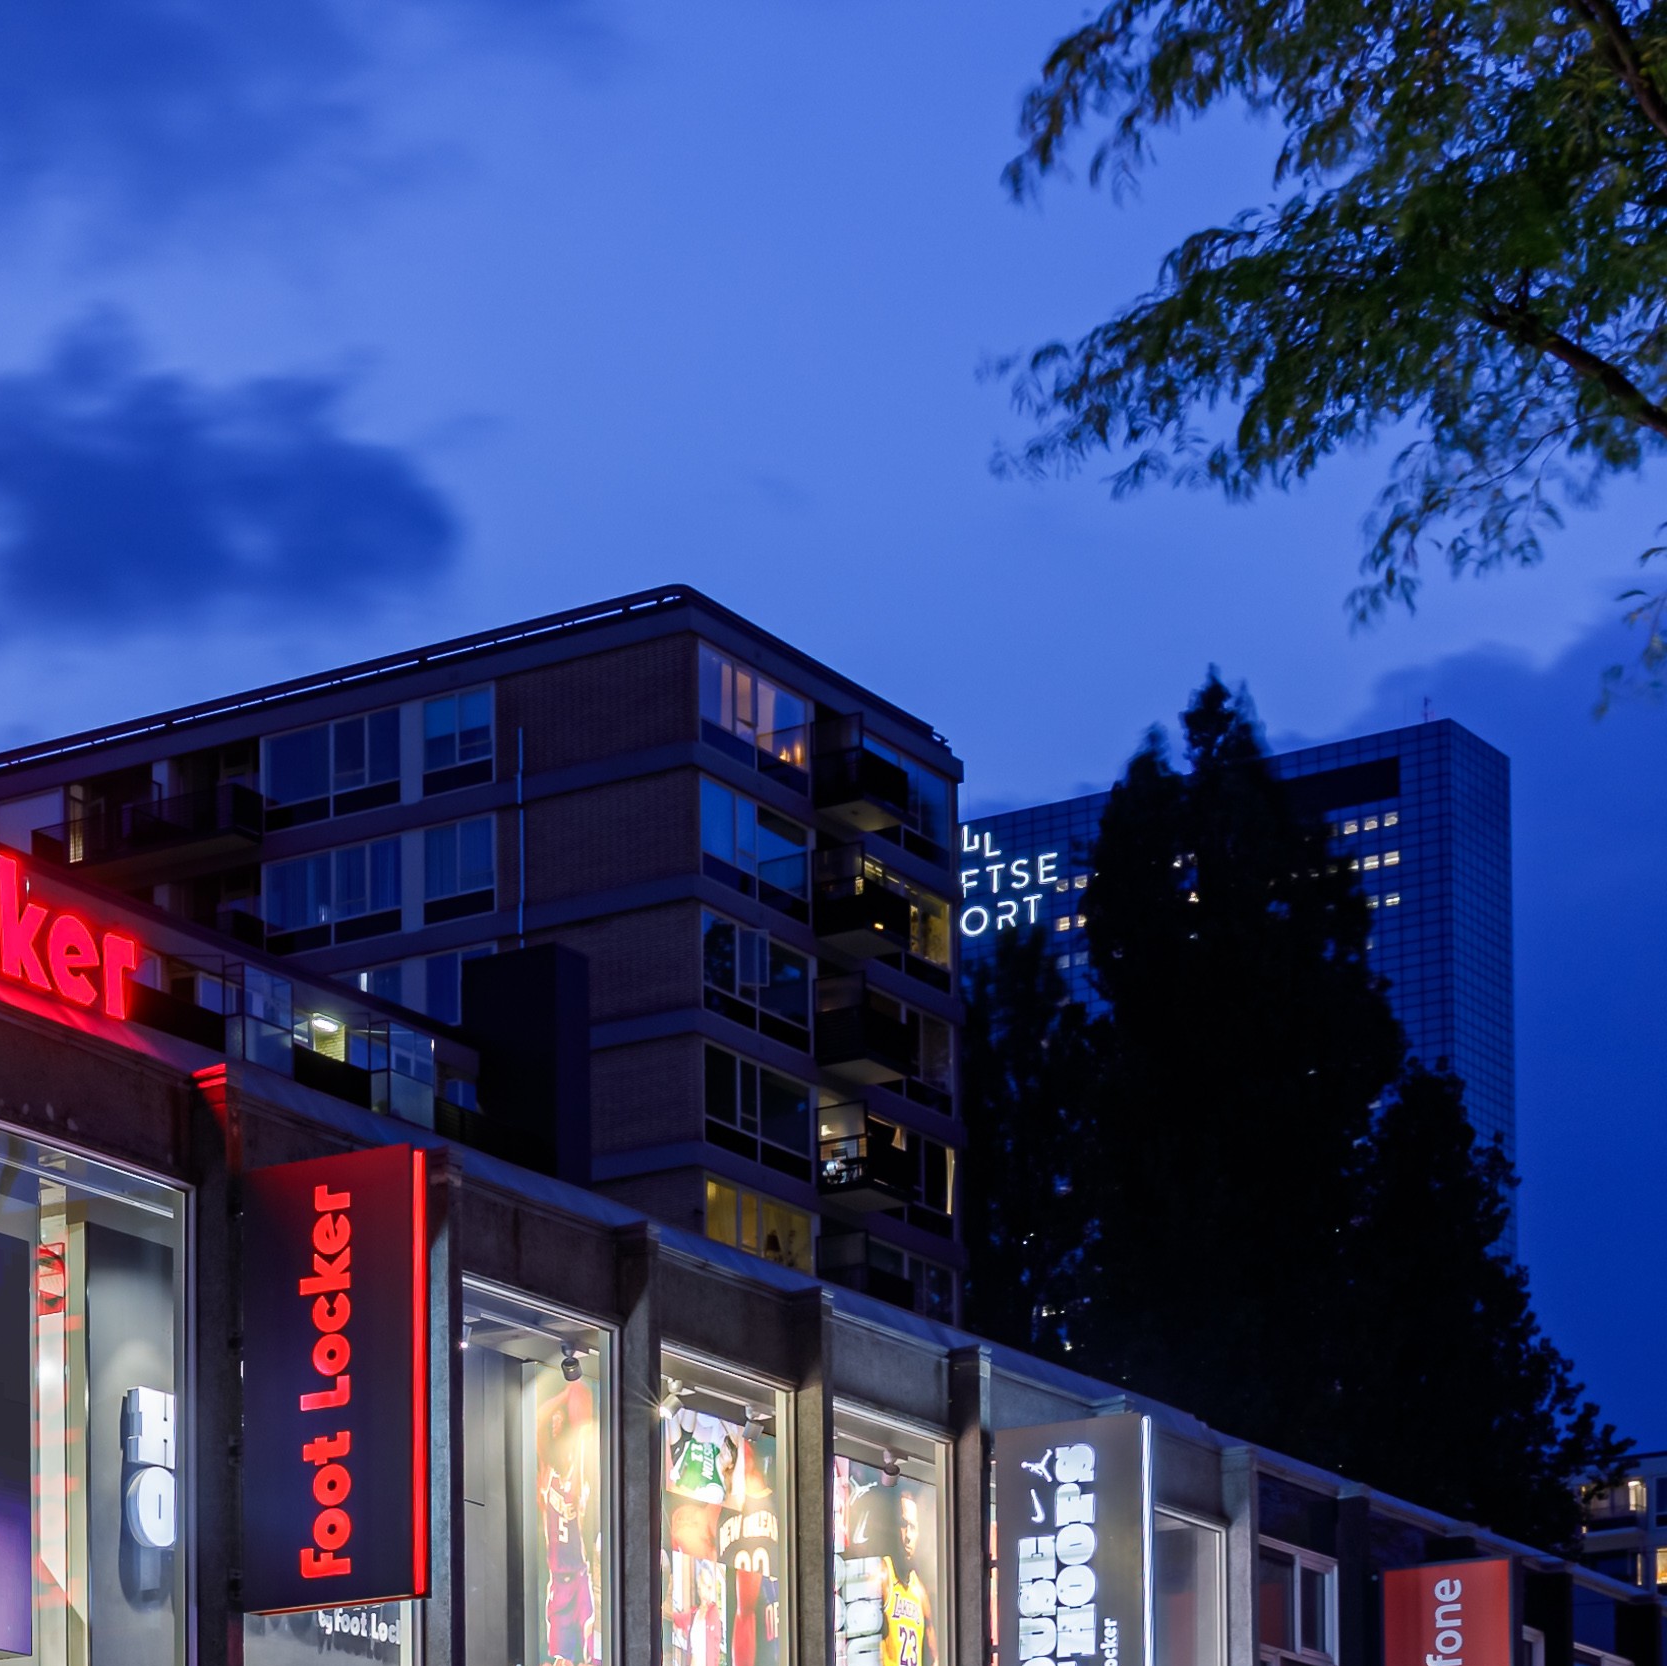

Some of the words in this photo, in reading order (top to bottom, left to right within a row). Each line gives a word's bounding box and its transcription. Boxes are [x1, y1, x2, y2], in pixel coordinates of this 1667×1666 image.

[298, 1184, 352, 1412] Locker
[298, 1431, 352, 1579] Foot
[1054, 1442, 1097, 1658] HOOPS
